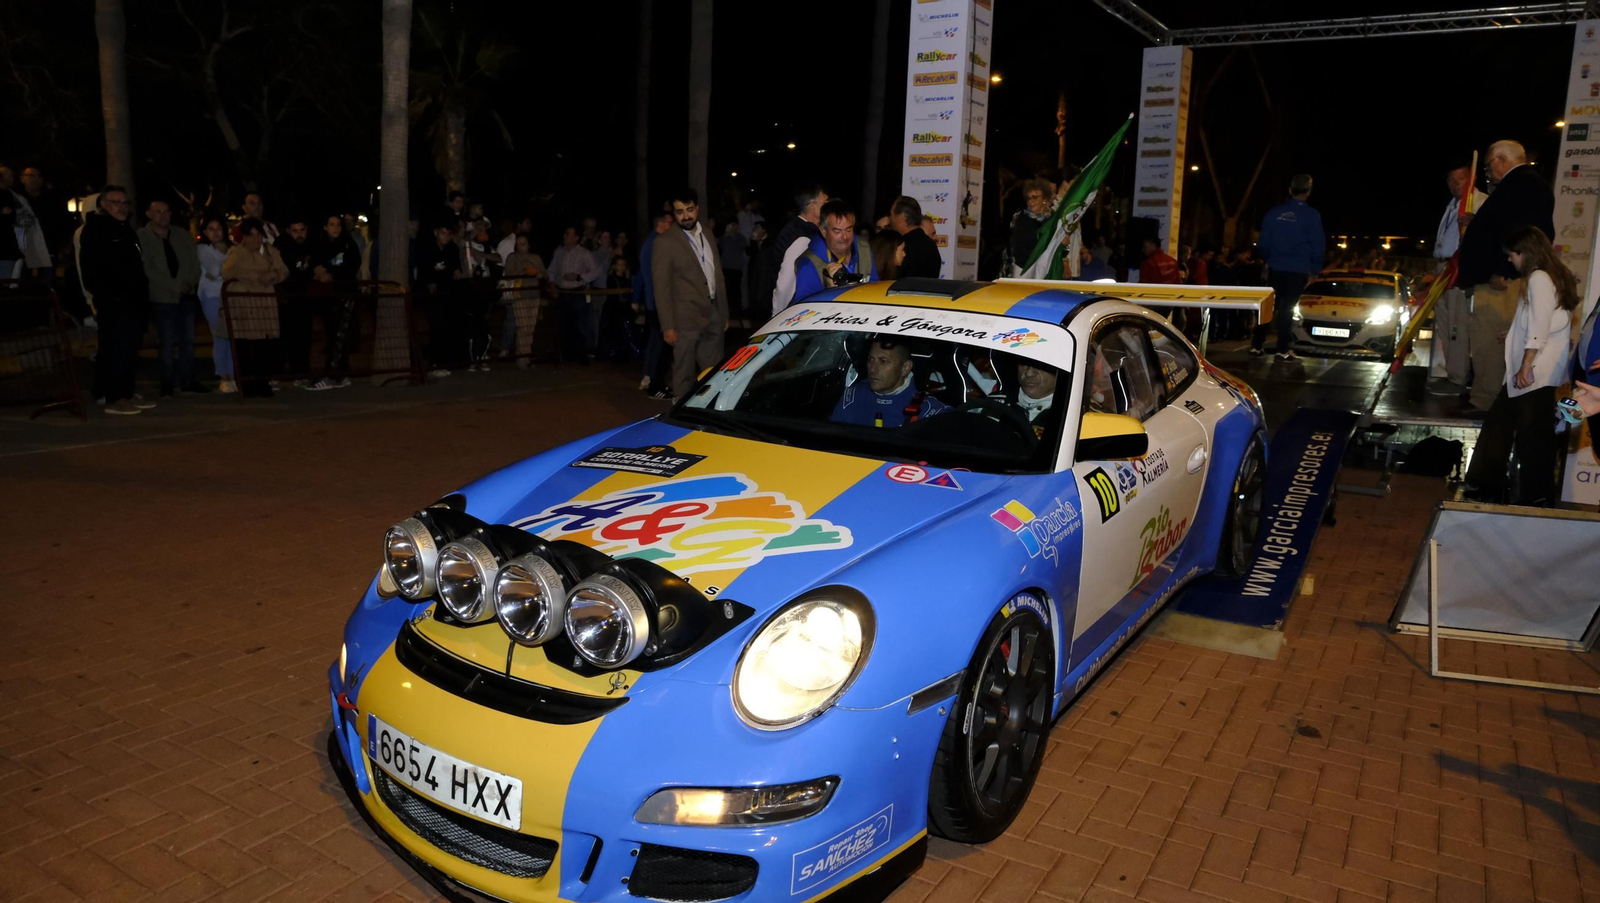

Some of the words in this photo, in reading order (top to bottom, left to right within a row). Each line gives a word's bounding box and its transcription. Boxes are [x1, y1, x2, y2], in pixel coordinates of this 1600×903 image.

[917, 52, 957, 61] Rallycar
[913, 133, 953, 143] Rallycar
[812, 312, 869, 325] Arias
[876, 316, 897, 326] &
[898, 317, 988, 339] Góngora
[617, 452, 689, 465] RALLYE
[1145, 453, 1160, 467] COSTA
[1147, 458, 1169, 485] ALMERÍA
[894, 467, 920, 481] E
[1090, 472, 1117, 517] 10
[1053, 520, 1081, 544] impresores
[531, 558, 561, 589] RALLY
[607, 578, 642, 612] RALLY
[1017, 596, 1049, 625] MICHELIN
[380, 729, 438, 791] 6654
[451, 764, 513, 821] HXX
[828, 835, 855, 853] Repair
[854, 823, 874, 838] Shop
[798, 828, 877, 881] SANCHEZ
